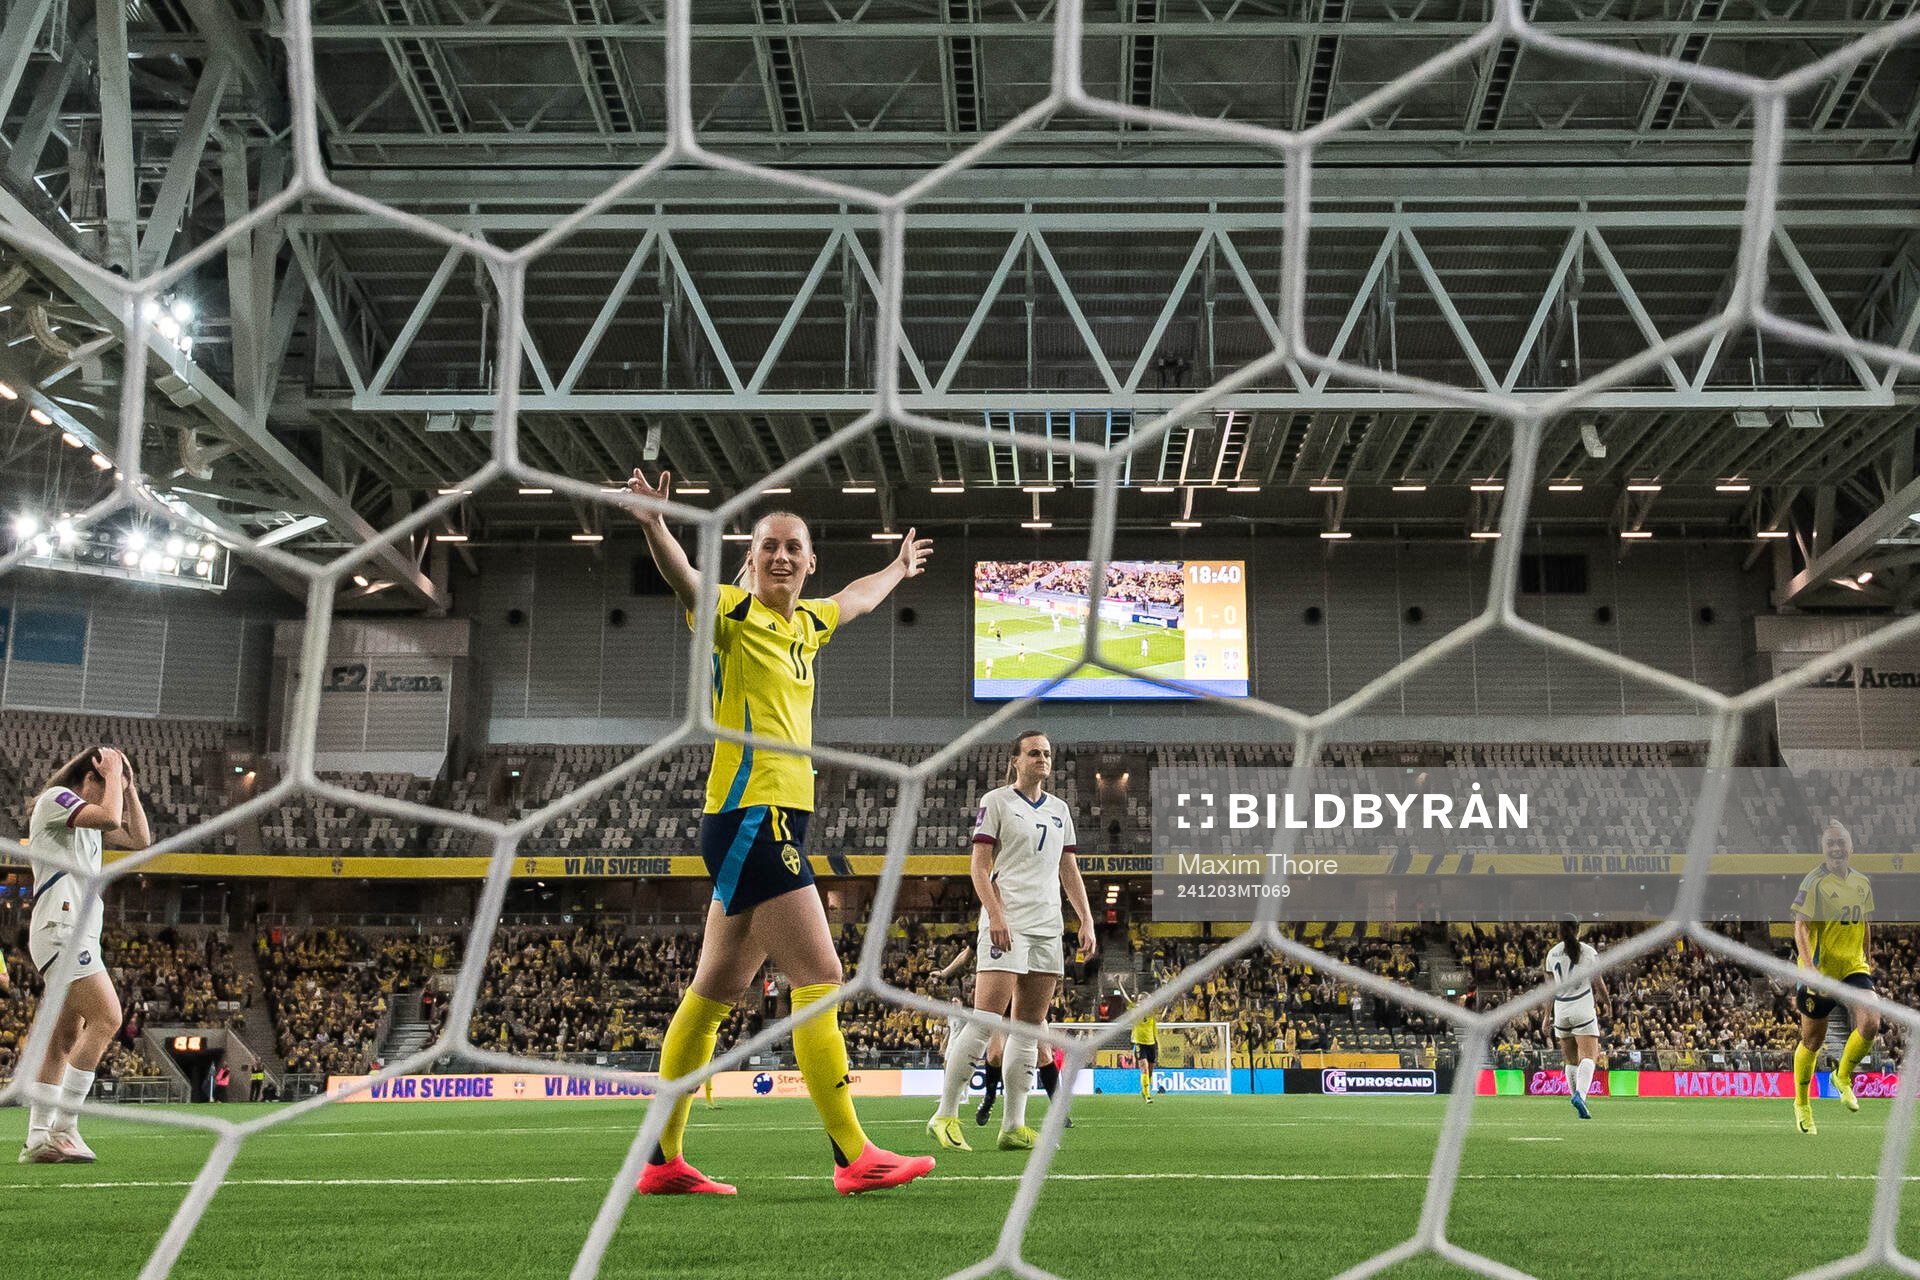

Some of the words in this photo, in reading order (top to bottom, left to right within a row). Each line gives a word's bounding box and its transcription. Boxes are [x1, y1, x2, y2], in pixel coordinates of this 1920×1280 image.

[1188, 565, 1241, 584] 18:40
[1195, 605, 1205, 624] 1
[1223, 604, 1237, 625] 0
[789, 640, 807, 680] 11
[370, 670, 443, 692] Arena
[1861, 666, 1920, 689] Aren
[1035, 823, 1047, 852] 7
[565, 858, 580, 875] VI
[583, 857, 605, 875] ÄR
[607, 858, 672, 875] SVERIGE
[1562, 856, 1579, 873] VI
[1840, 905, 1861, 925] 20
[370, 1078, 388, 1098] VI
[420, 1077, 494, 1098] SVERIGE
[545, 1076, 562, 1096] VI
[1151, 1071, 1229, 1092] Folksam
[1332, 1074, 1433, 1090] HYDROSCAND
[1674, 1072, 1780, 1096] MATCHDAX
